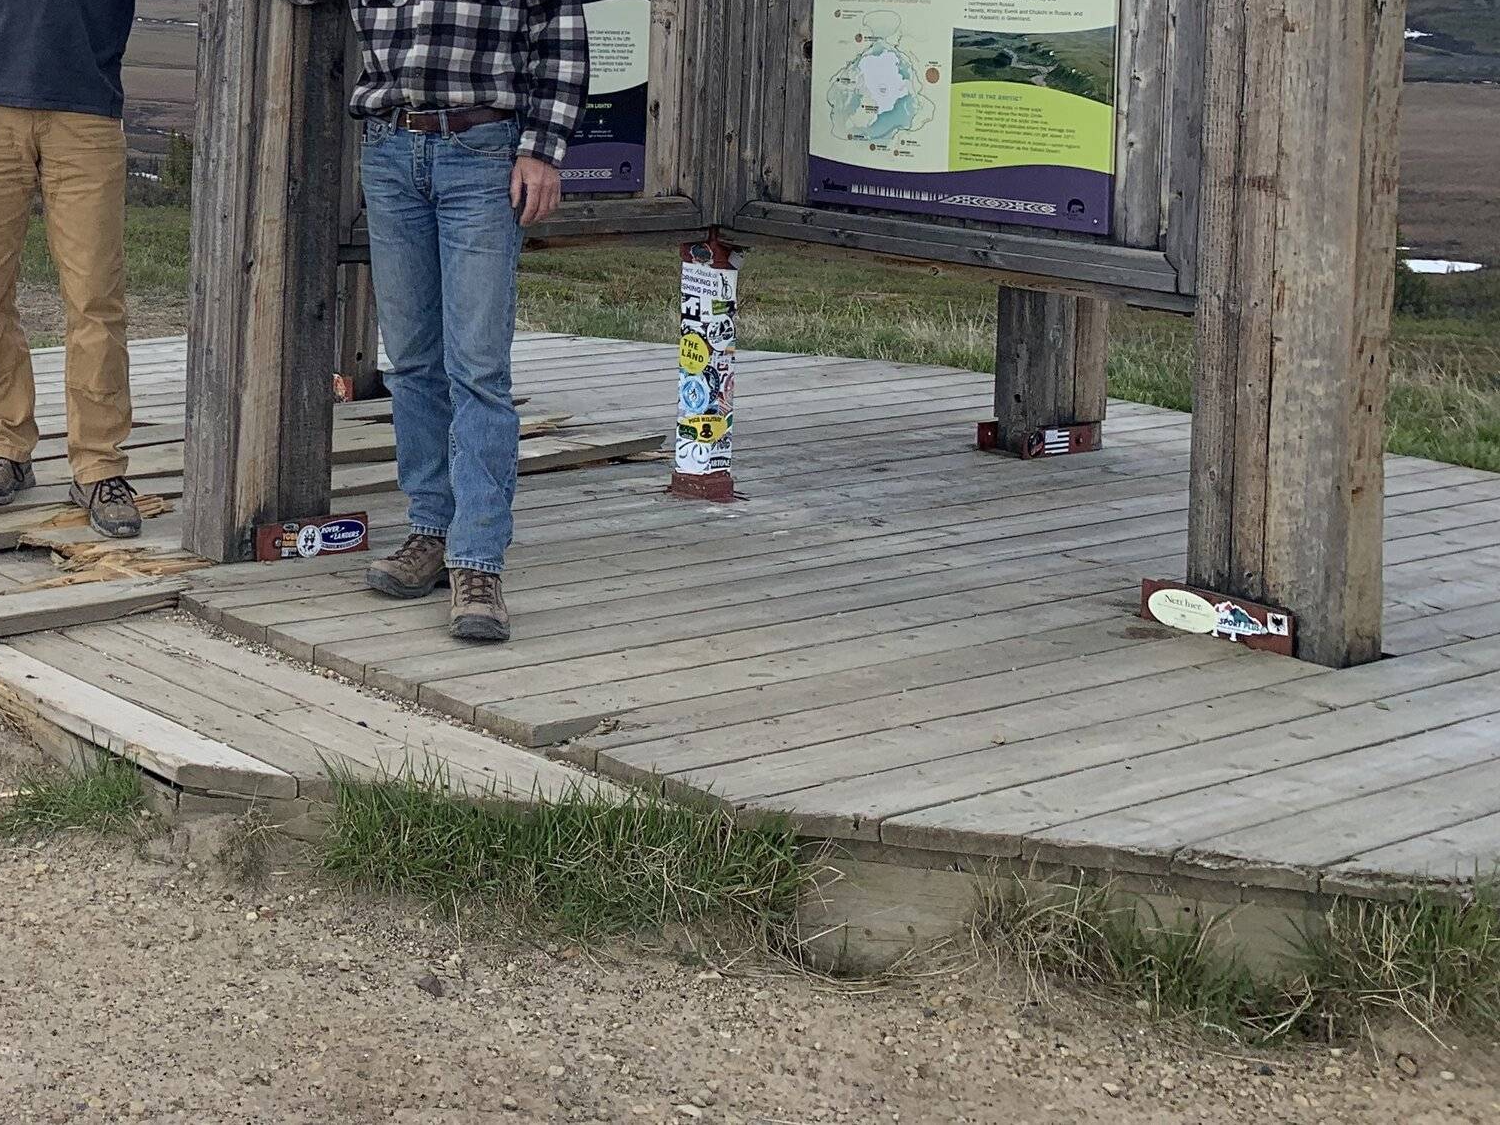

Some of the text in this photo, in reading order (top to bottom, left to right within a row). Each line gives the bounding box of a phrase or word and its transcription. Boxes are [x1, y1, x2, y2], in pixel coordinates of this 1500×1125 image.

[684, 338, 699, 350] THE
[681, 349, 704, 363] LÄND
[1219, 618, 1242, 626] SPORT
